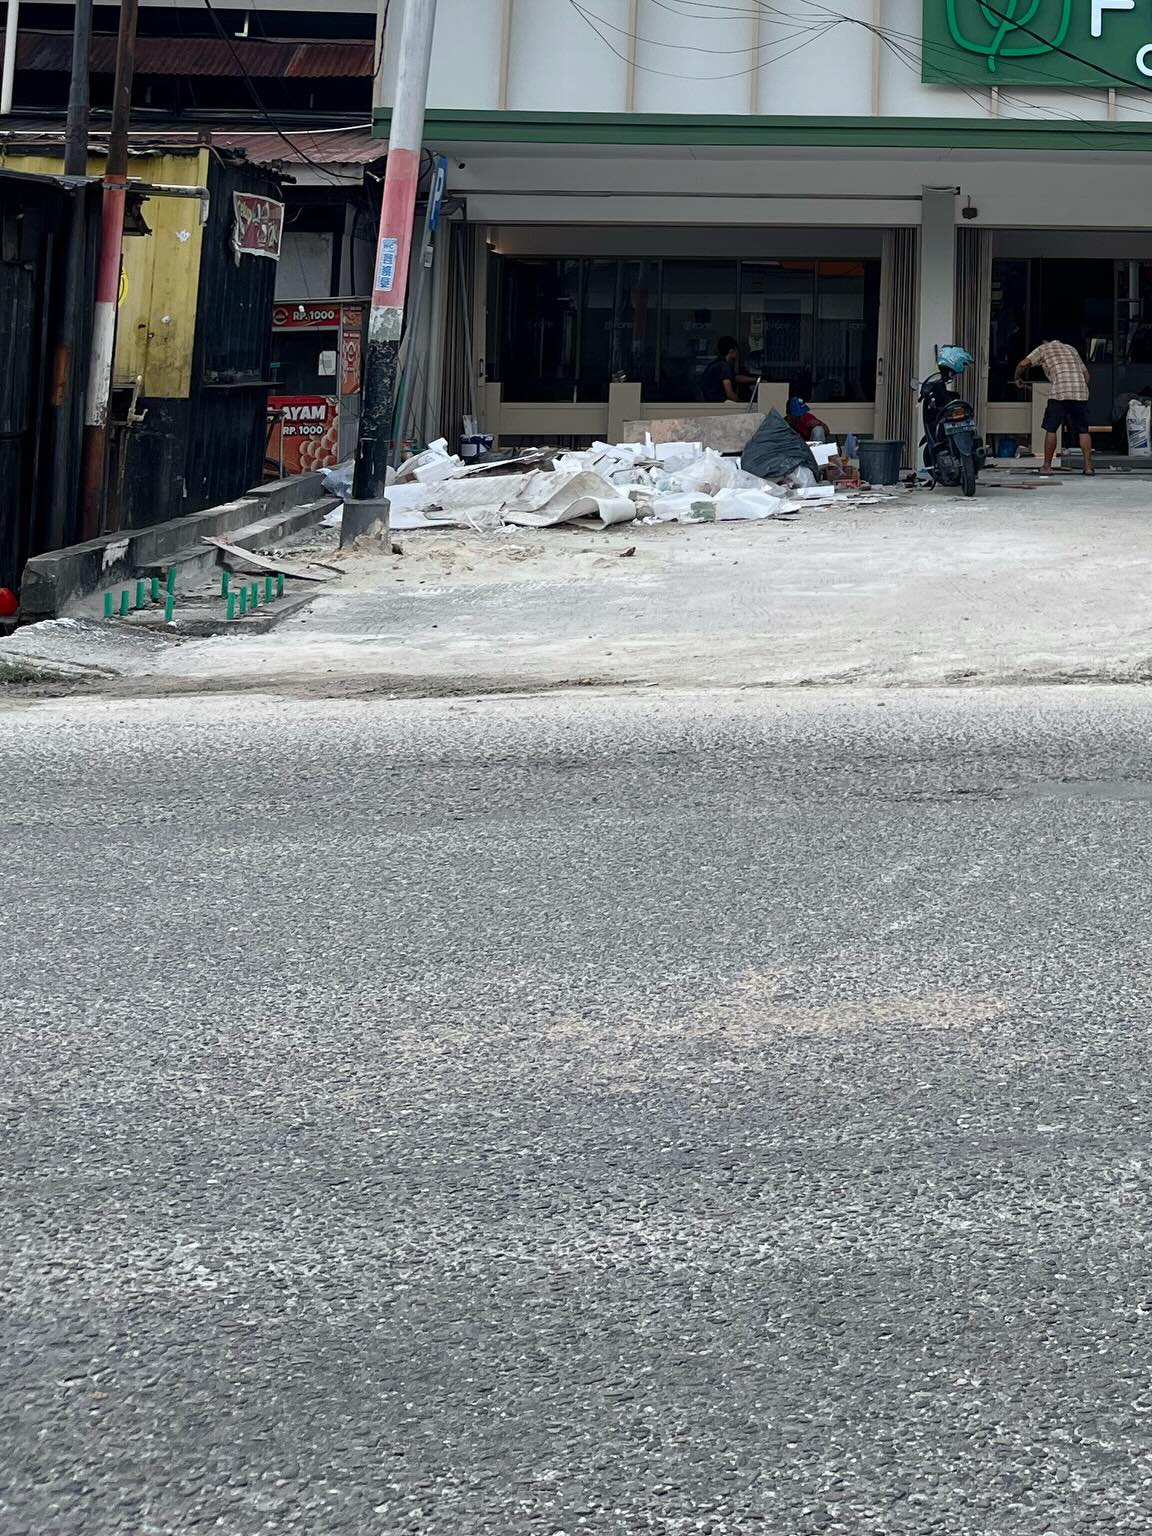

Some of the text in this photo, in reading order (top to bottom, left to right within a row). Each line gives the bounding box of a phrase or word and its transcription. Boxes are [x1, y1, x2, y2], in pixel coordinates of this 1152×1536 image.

[310, 310, 335, 320] 1000
[283, 405, 327, 421] AYAM
[282, 425, 323, 435] RP. 1000
